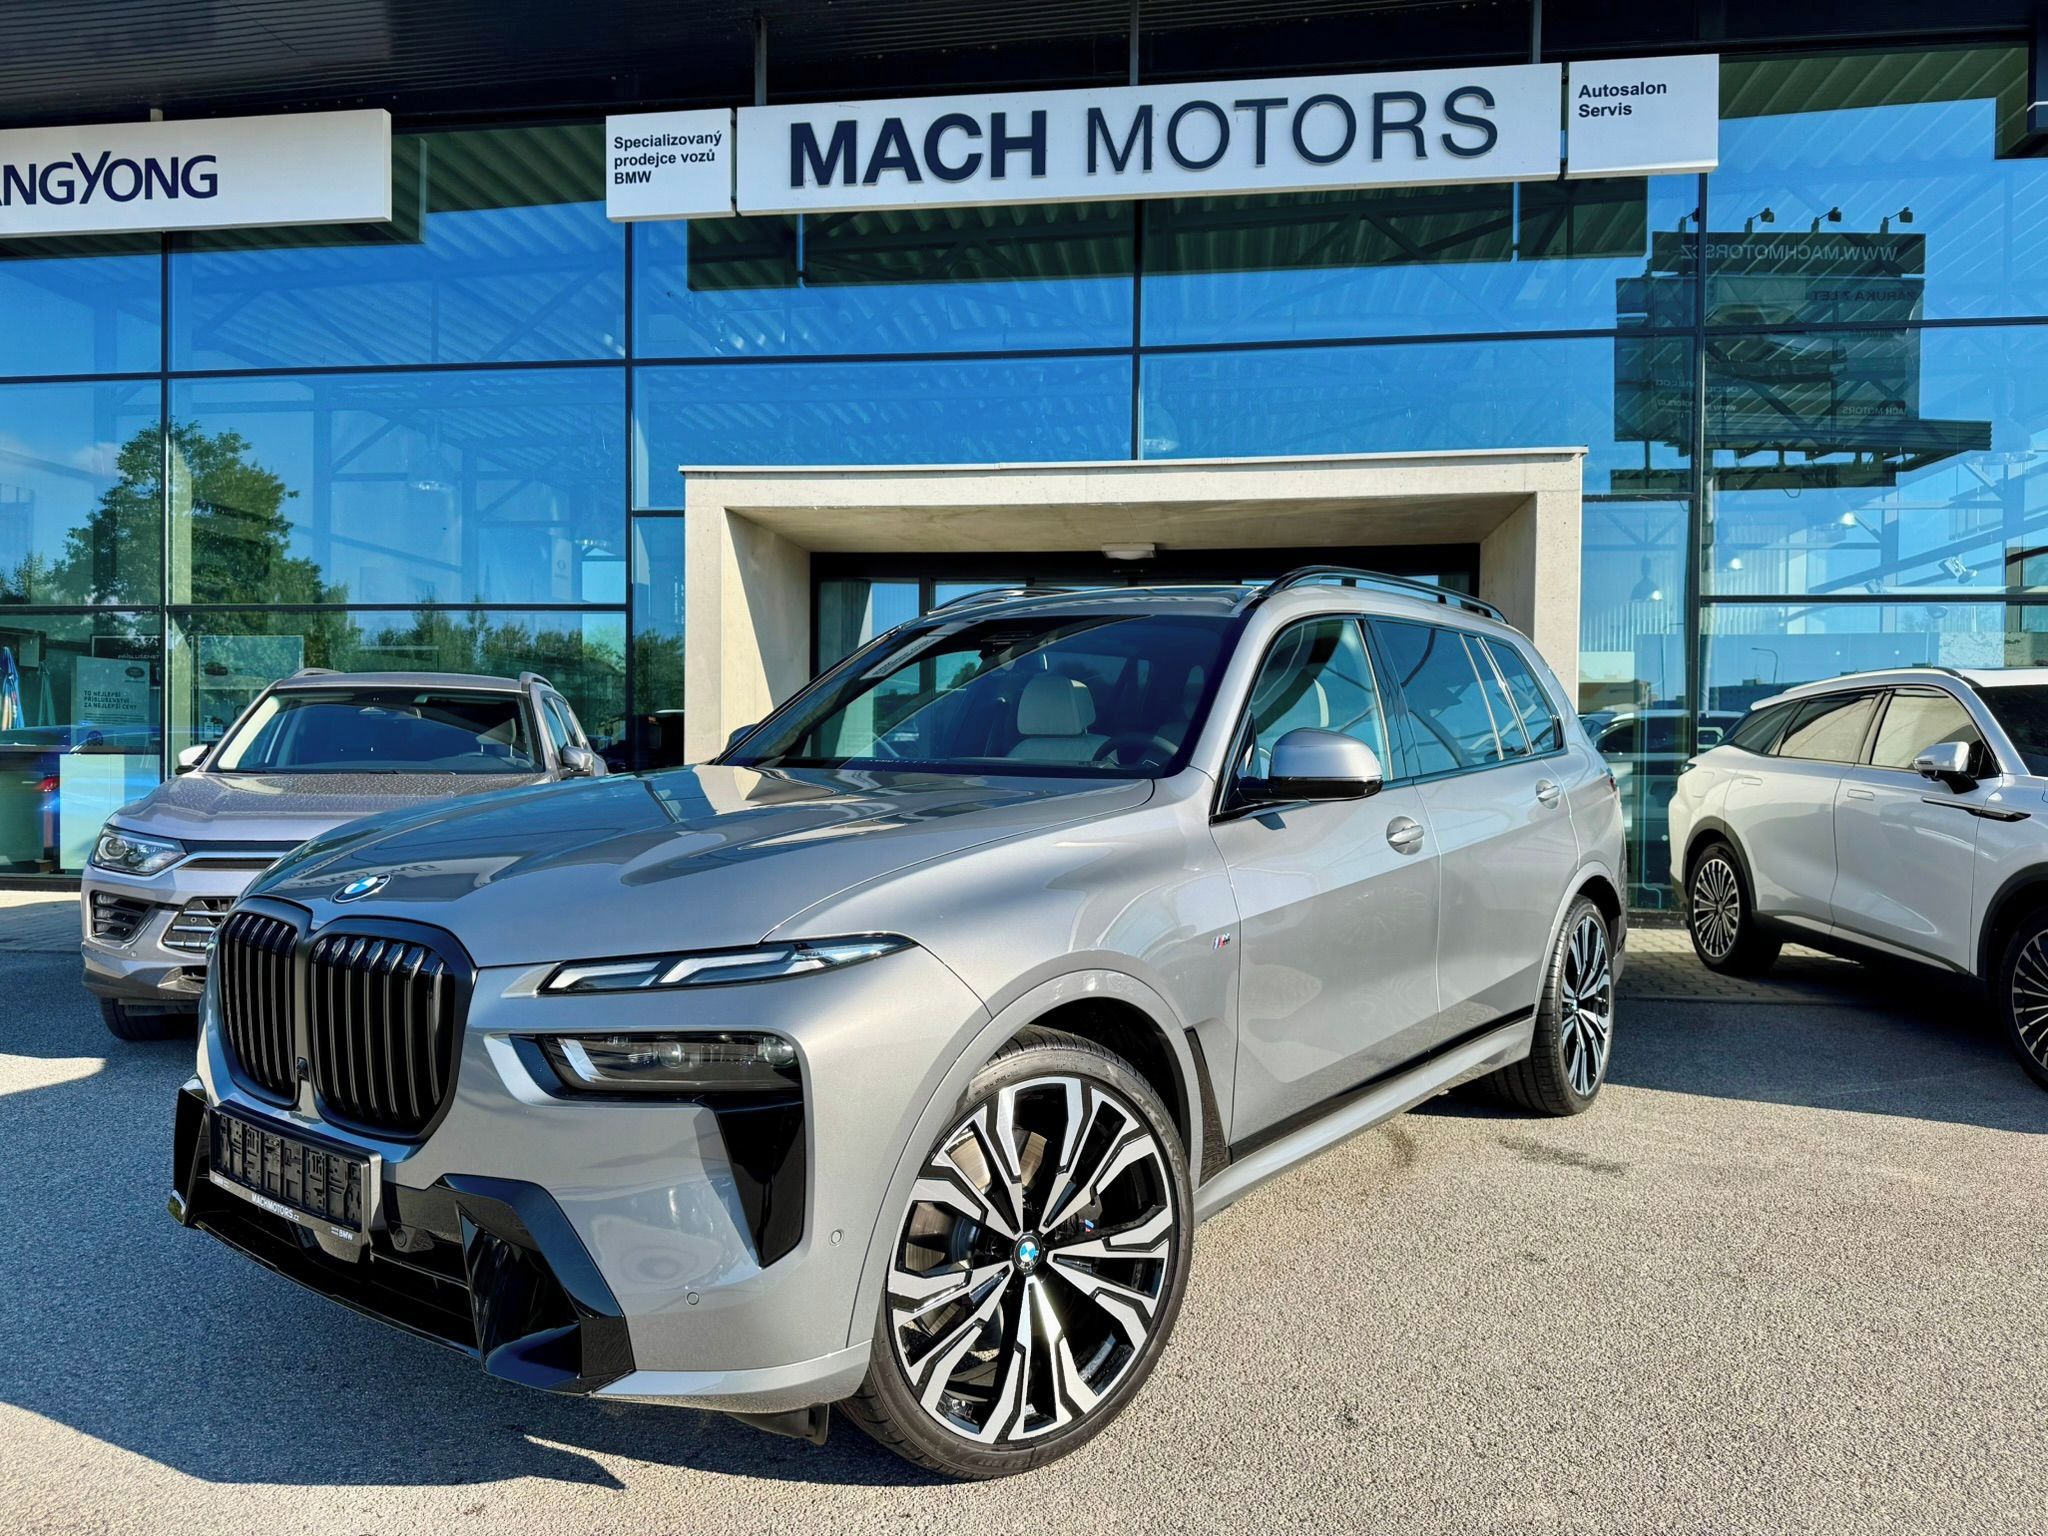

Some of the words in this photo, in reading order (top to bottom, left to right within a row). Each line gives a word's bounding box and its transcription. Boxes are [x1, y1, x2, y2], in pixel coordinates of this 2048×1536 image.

[1578, 81, 1667, 99] Autosalon
[1578, 102, 1632, 118] Servis
[614, 130, 722, 151] Specializovaný
[791, 110, 1047, 189] MACH
[1087, 85, 1498, 175] MOTORS
[614, 152, 676, 170] prodejce
[680, 148, 715, 163] vozů
[0, 151, 218, 206] NGYONG
[614, 170, 652, 185] BMW
